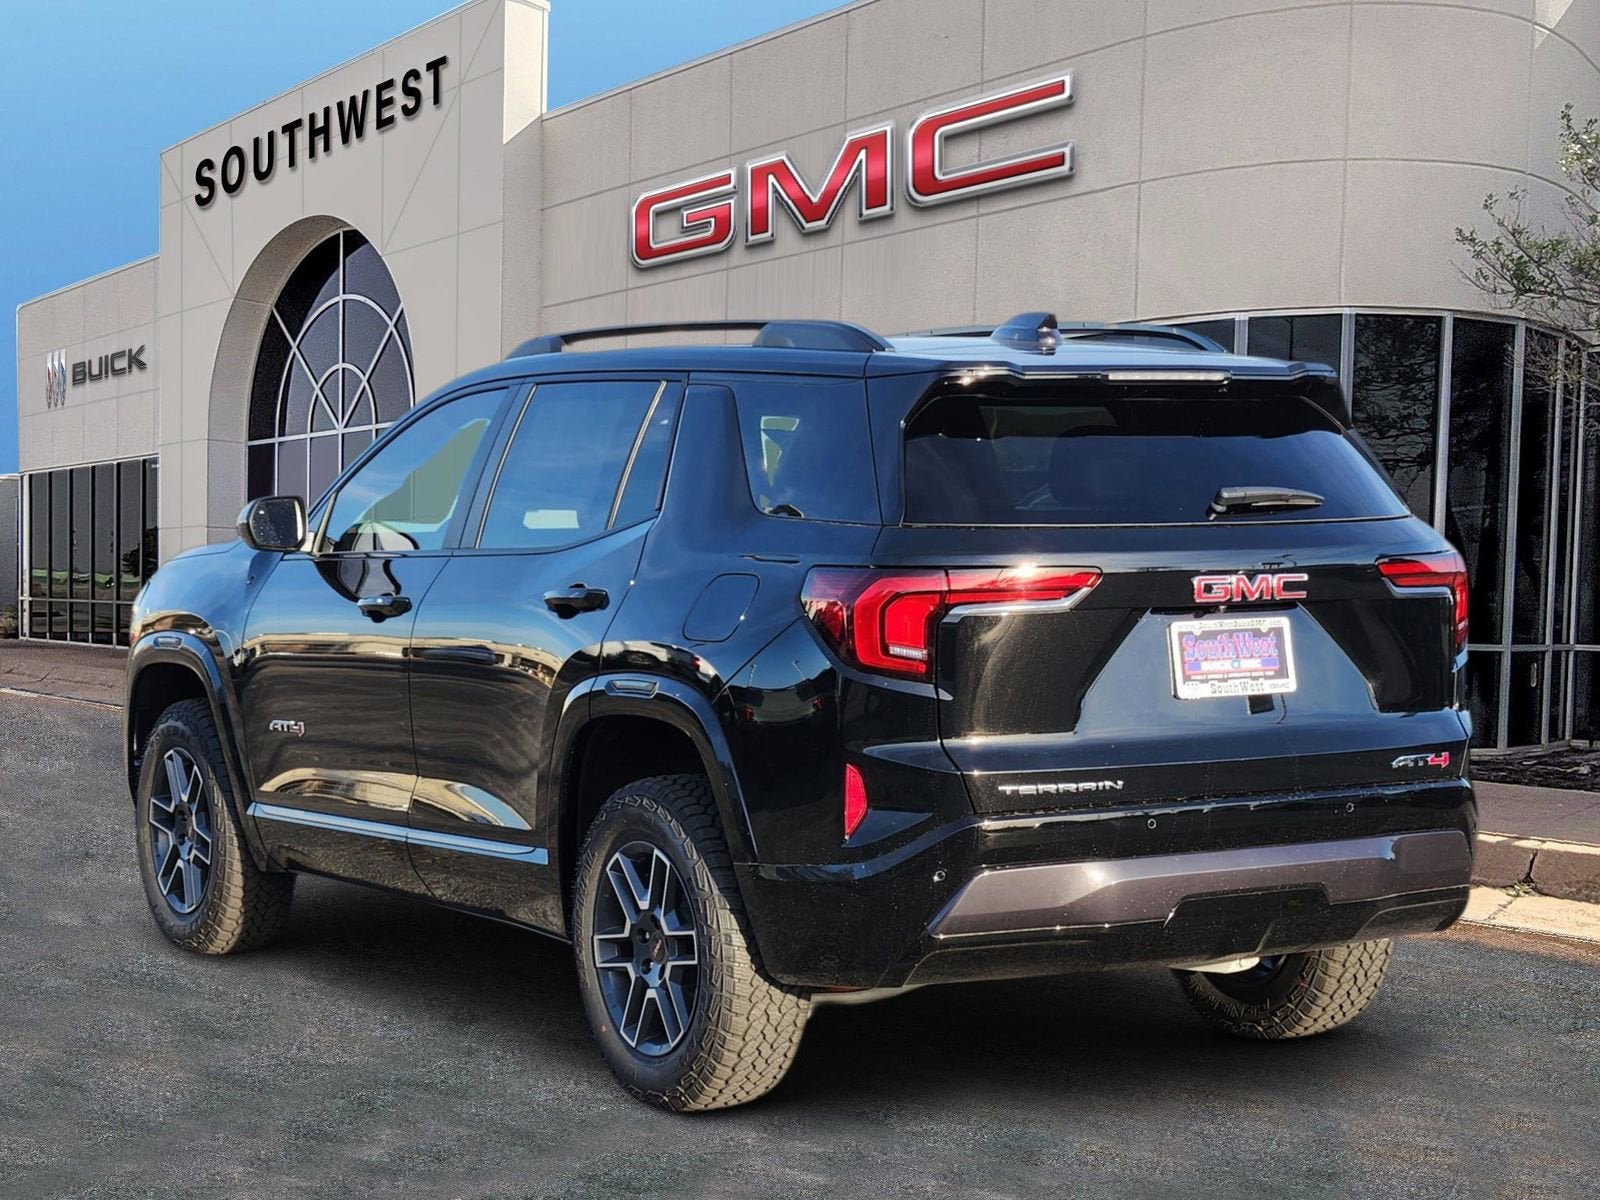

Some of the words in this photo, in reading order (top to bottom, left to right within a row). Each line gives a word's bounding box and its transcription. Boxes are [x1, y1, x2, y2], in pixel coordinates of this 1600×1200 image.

[194, 55, 449, 207] SOUTHWEST
[631, 69, 1074, 268] GMC
[72, 345, 147, 386] BUICK
[1192, 573, 1308, 602] GMC
[269, 719, 305, 737] AT4
[1391, 751, 1450, 769] AT4
[998, 780, 1123, 795] TERRAIN
